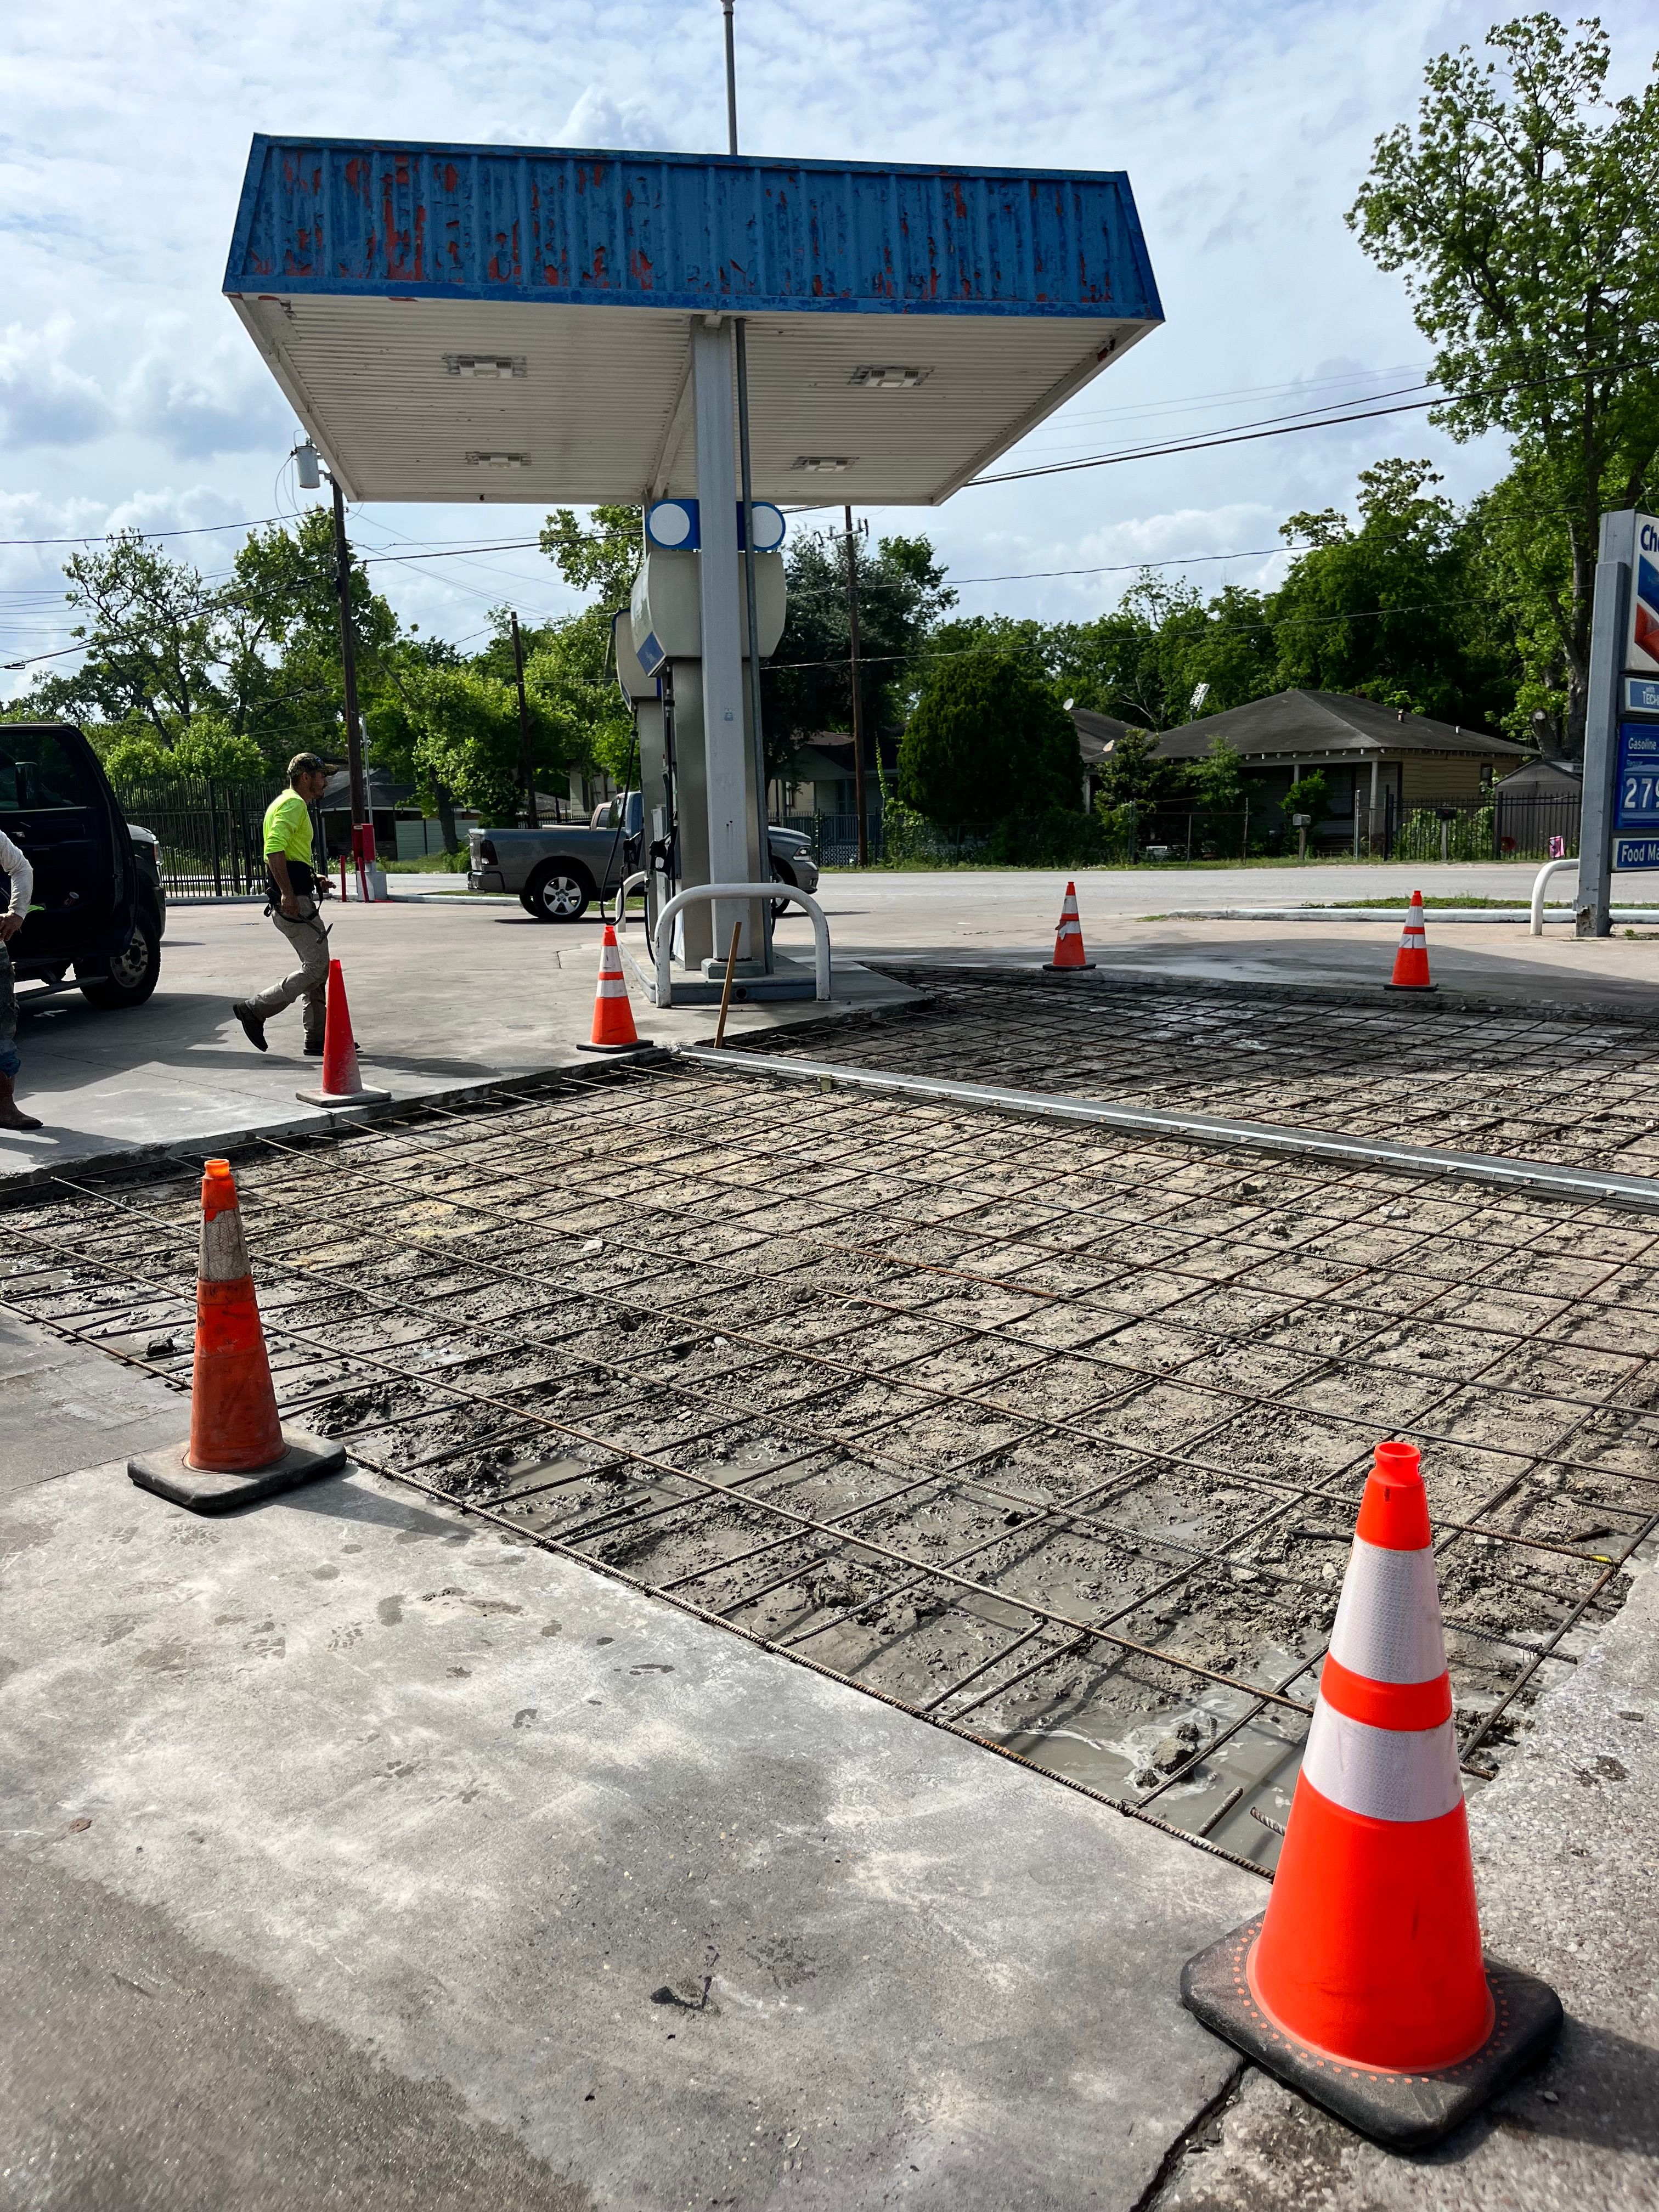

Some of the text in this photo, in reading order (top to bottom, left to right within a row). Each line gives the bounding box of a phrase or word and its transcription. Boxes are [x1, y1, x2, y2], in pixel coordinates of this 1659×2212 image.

[1641, 524, 1659, 552] Ch
[1628, 737, 1657, 750] Gasoline
[1622, 844, 1645, 862] Food
